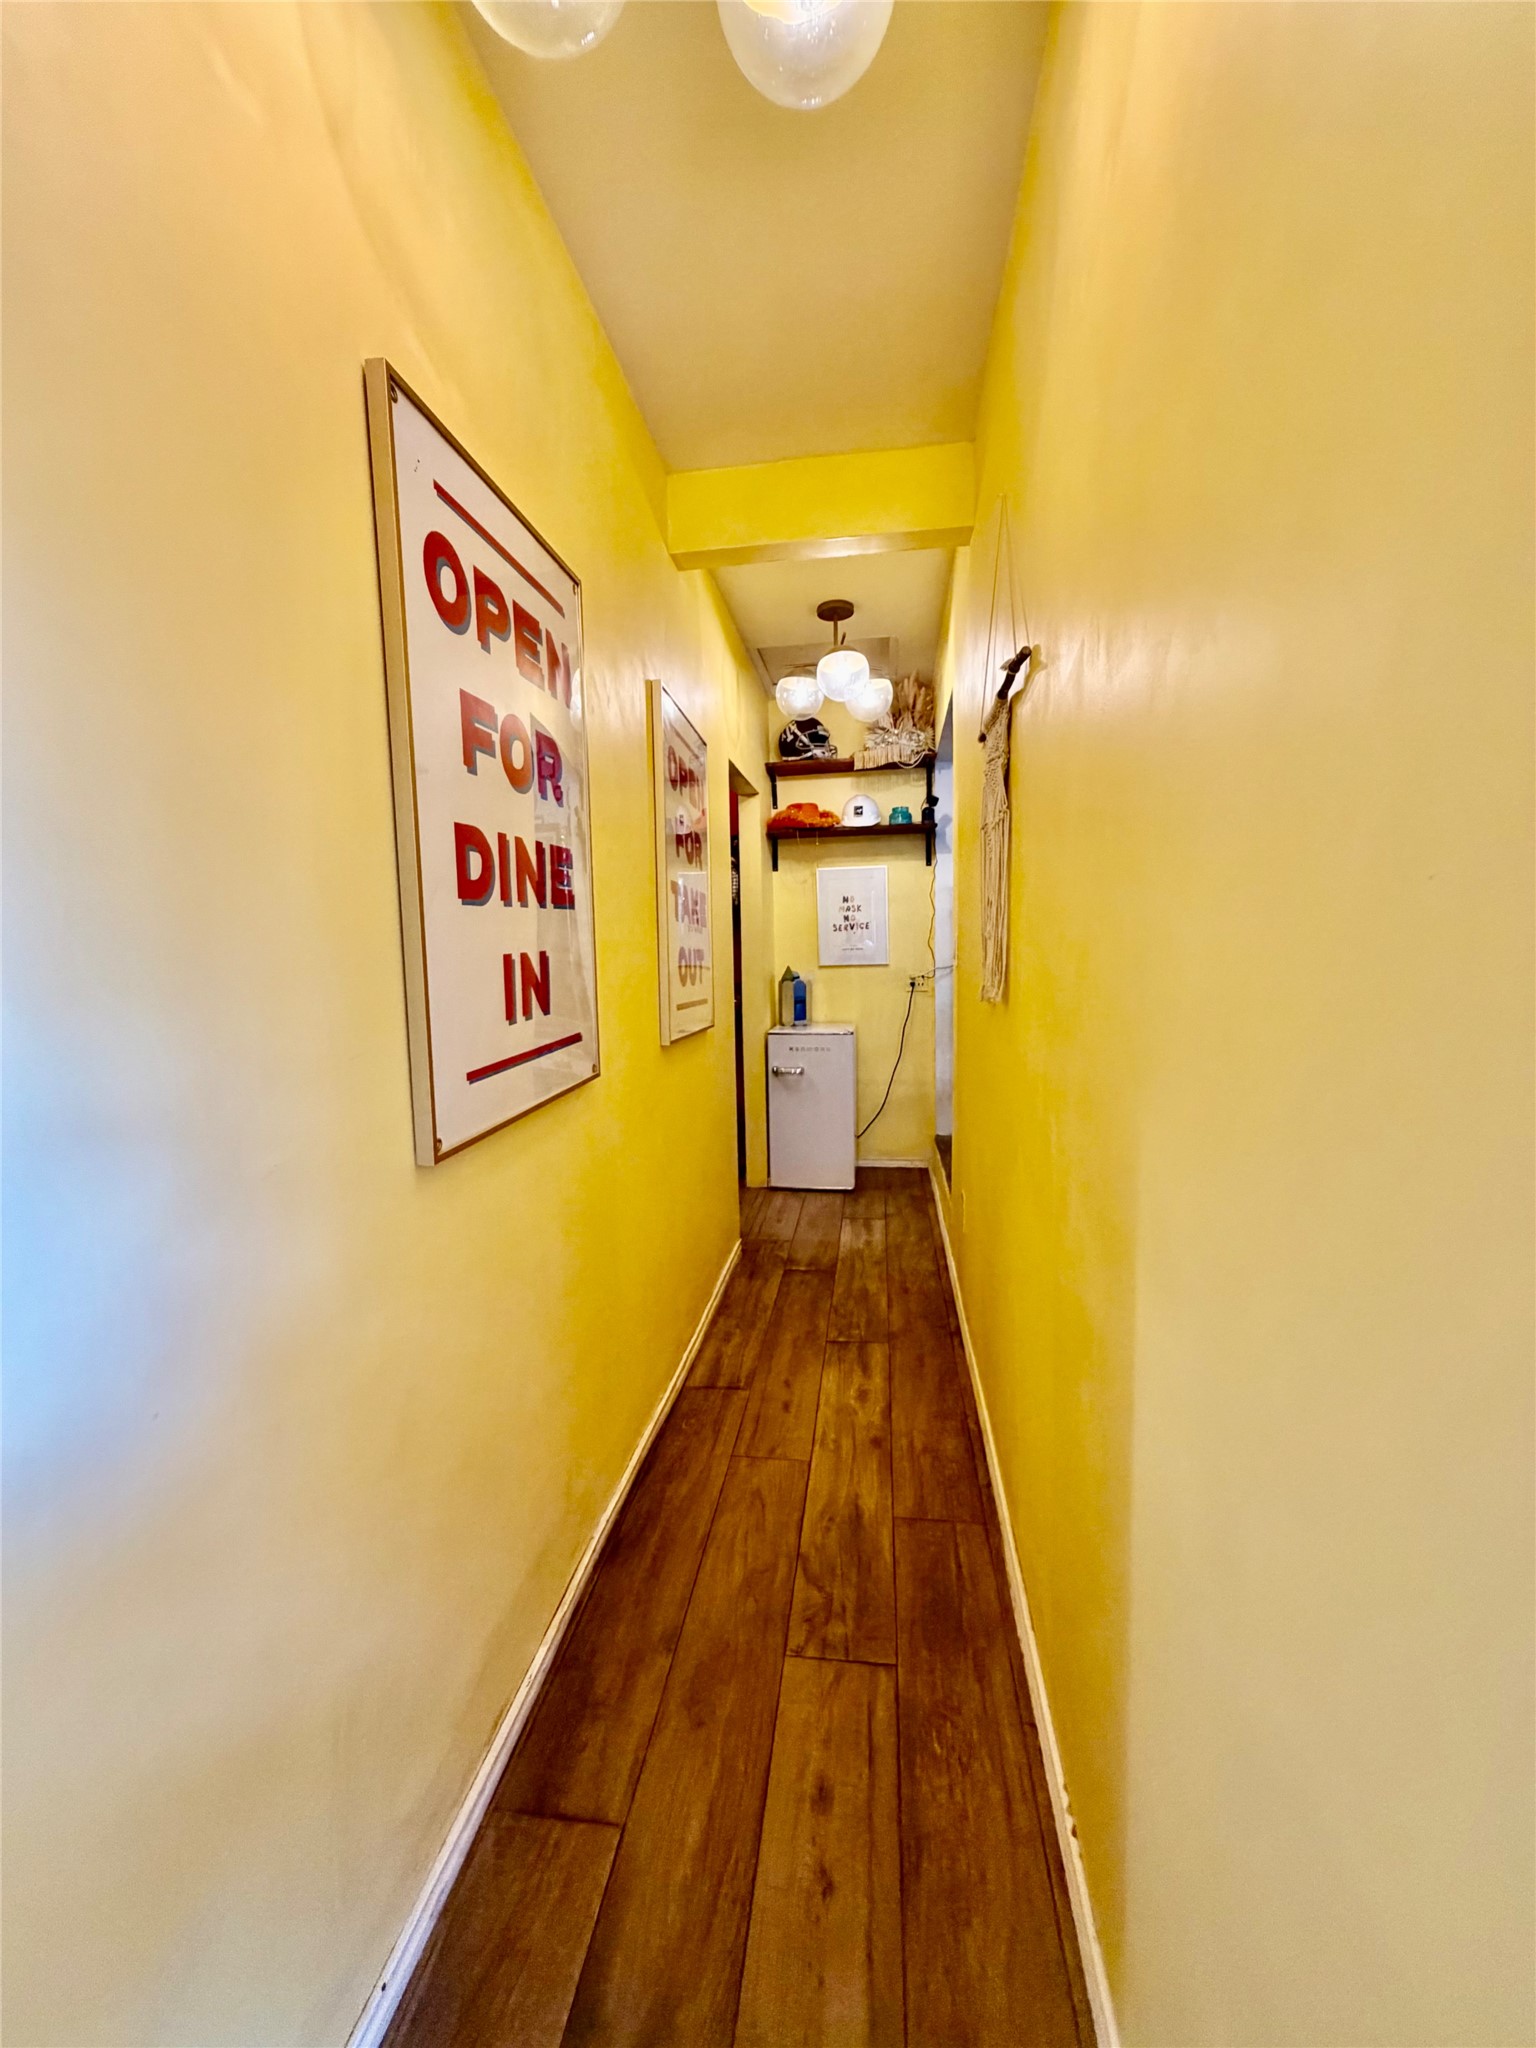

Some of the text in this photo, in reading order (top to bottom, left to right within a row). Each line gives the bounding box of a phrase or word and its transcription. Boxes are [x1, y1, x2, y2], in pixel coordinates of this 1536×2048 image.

[423, 530, 573, 709] OPEN
[459, 688, 564, 807] FOR
[454, 822, 575, 910] DINE
[675, 816, 703, 870] FOR
[832, 922, 870, 932] SERVICE
[503, 951, 551, 1026] IN
[678, 946, 704, 987] OUT
